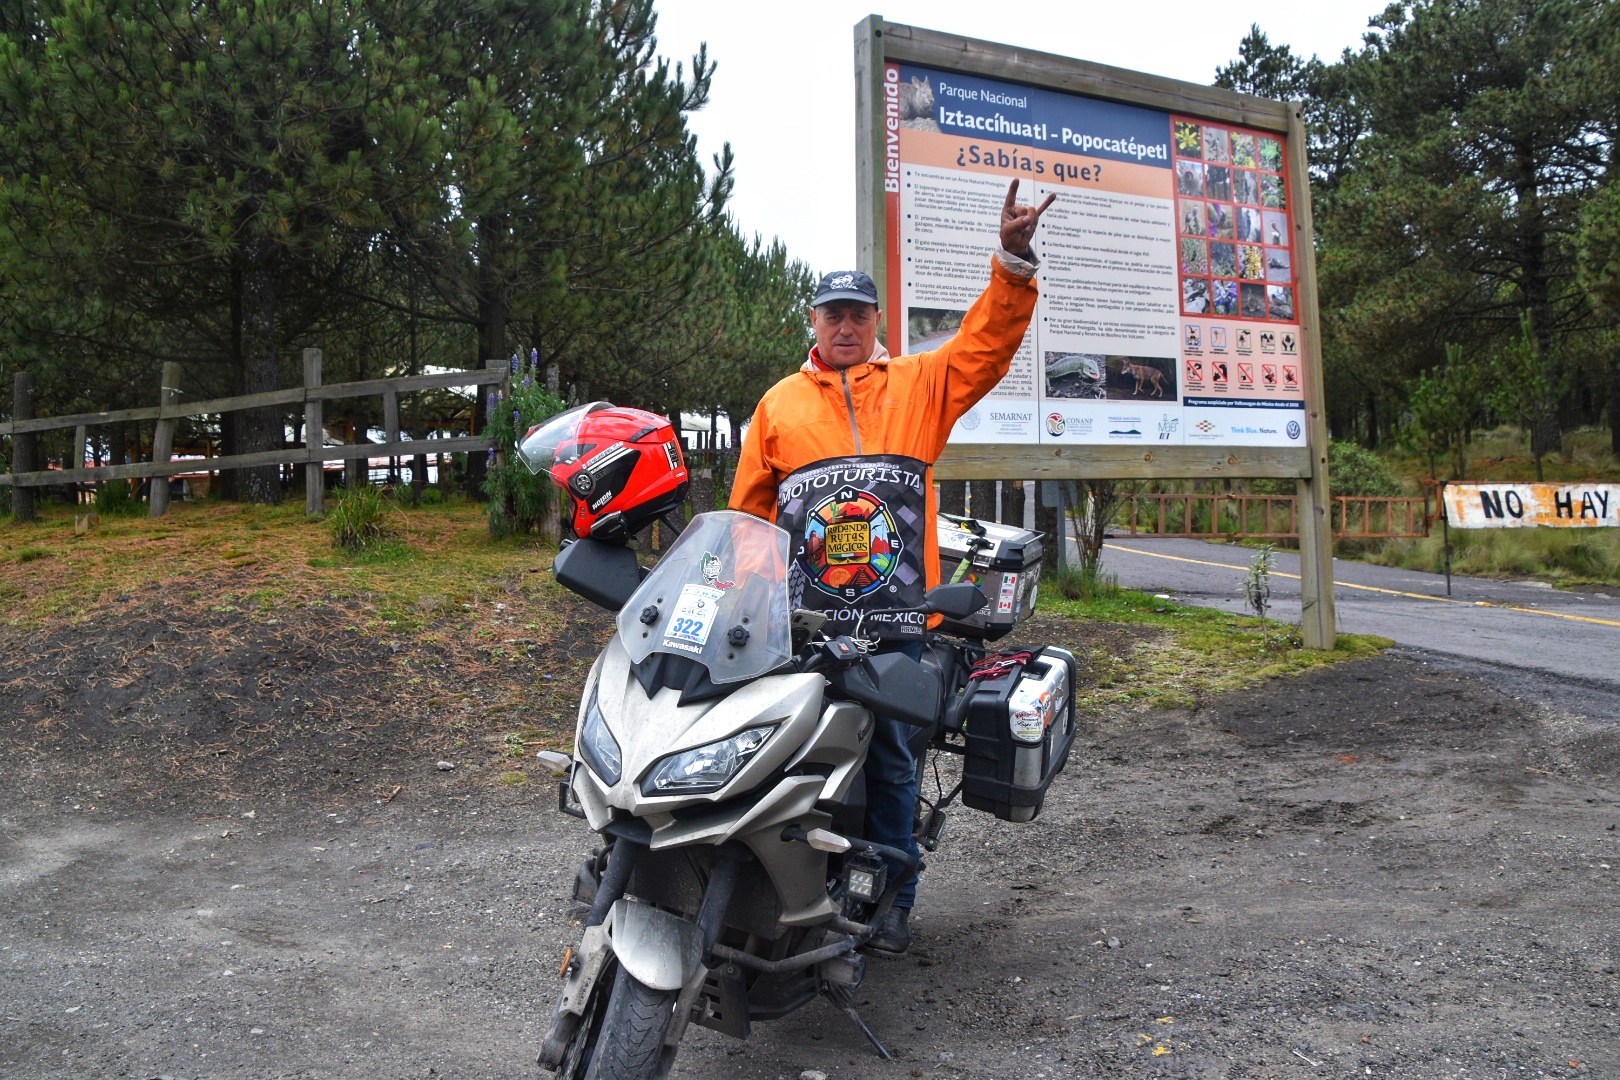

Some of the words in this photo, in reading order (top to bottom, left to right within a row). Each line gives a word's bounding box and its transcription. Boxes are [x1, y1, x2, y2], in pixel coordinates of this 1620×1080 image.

[940, 83, 978, 101] Parque
[981, 90, 1026, 108] Nacional
[884, 68, 898, 193] Bienvenido
[940, 107, 1047, 140] Iztaccíhuatl
[1062, 128, 1167, 160] Popocatépetl
[957, 145, 1044, 173] ¿Sabías
[1054, 163, 1102, 182] que?
[990, 412, 1032, 421] SEMARNAT
[780, 468, 920, 506] MOTOTURISTA
[841, 491, 853, 499] N
[1480, 490, 1523, 519] NO
[1554, 490, 1608, 519] HAY
[891, 540, 899, 548] E
[674, 618, 703, 636] 322
[663, 639, 703, 654] Kawasaki
